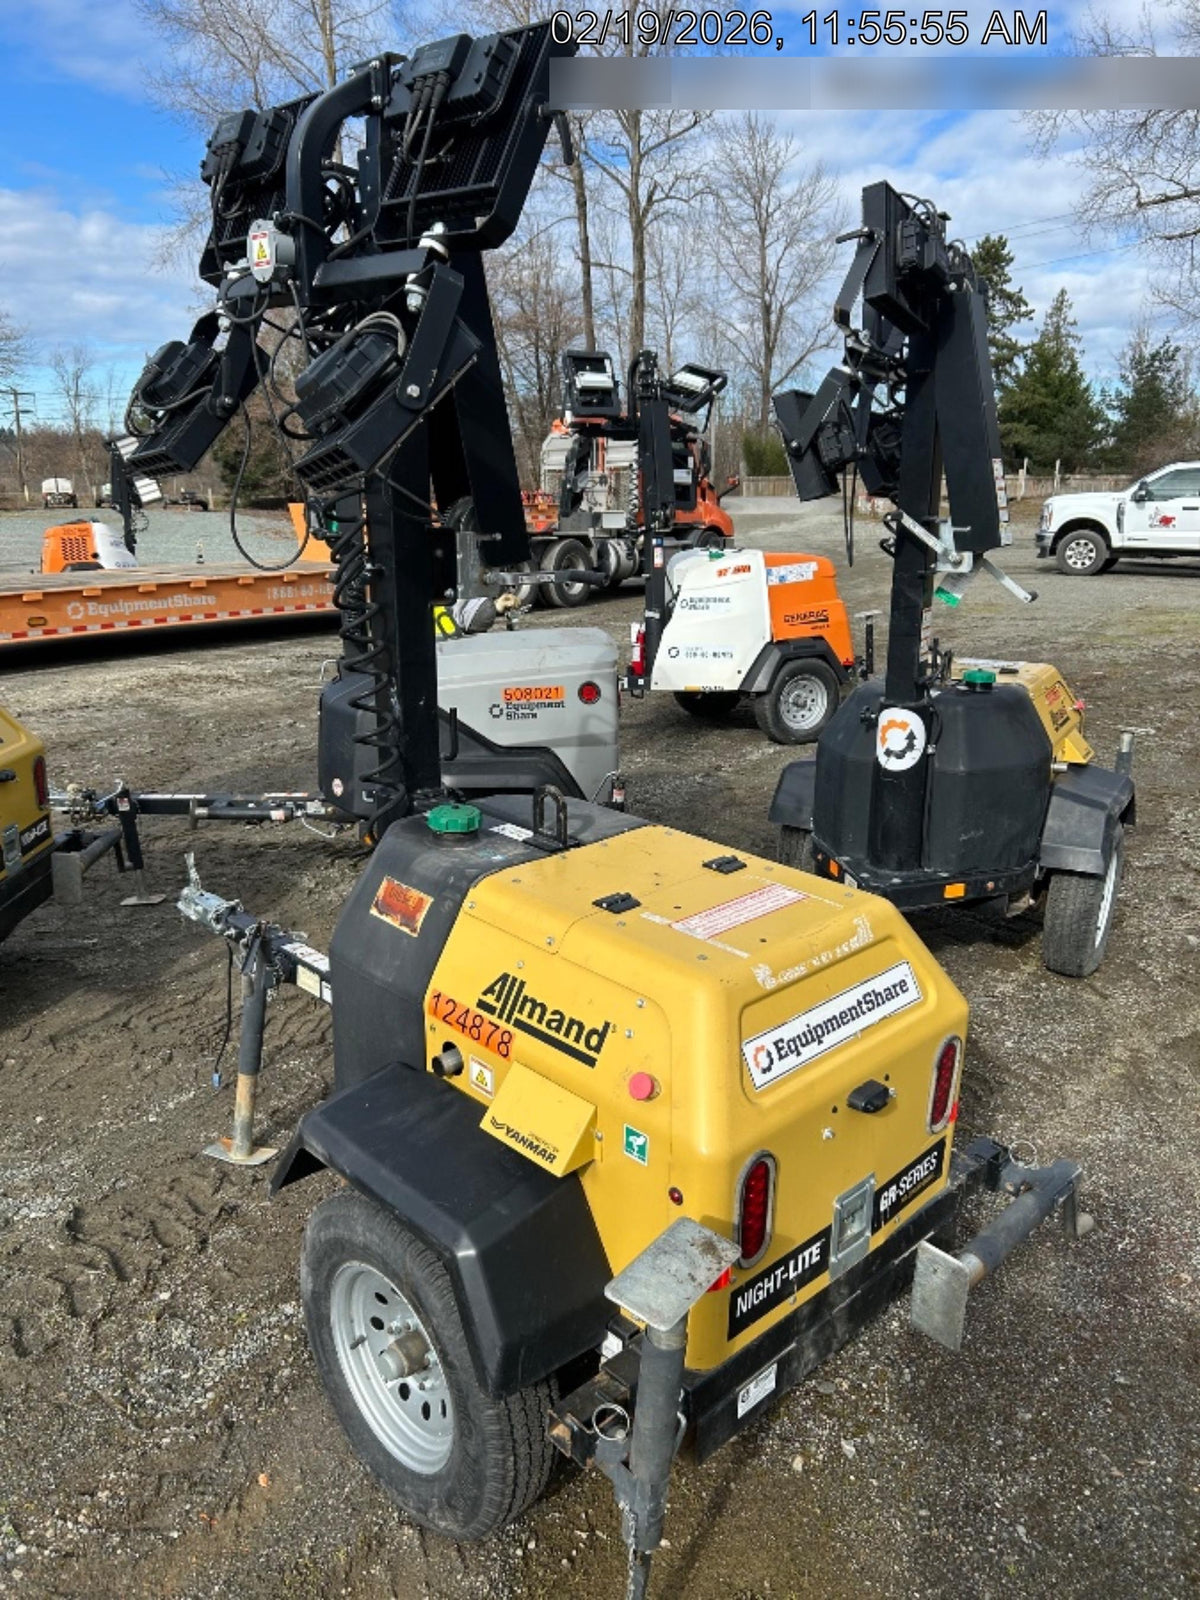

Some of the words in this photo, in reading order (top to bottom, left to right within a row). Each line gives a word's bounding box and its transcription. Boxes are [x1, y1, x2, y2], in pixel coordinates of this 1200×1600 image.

[87, 594, 217, 617] EquipmentShare
[504, 687, 559, 702] 508021
[431, 991, 515, 1059] 124878
[479, 972, 613, 1060] Allmand
[773, 978, 910, 1062] EquipmentShare
[505, 1125, 558, 1163] YANMAR
[880, 1151, 938, 1212] GR-SERIES
[736, 1240, 822, 1318] NIGHT-LITE
